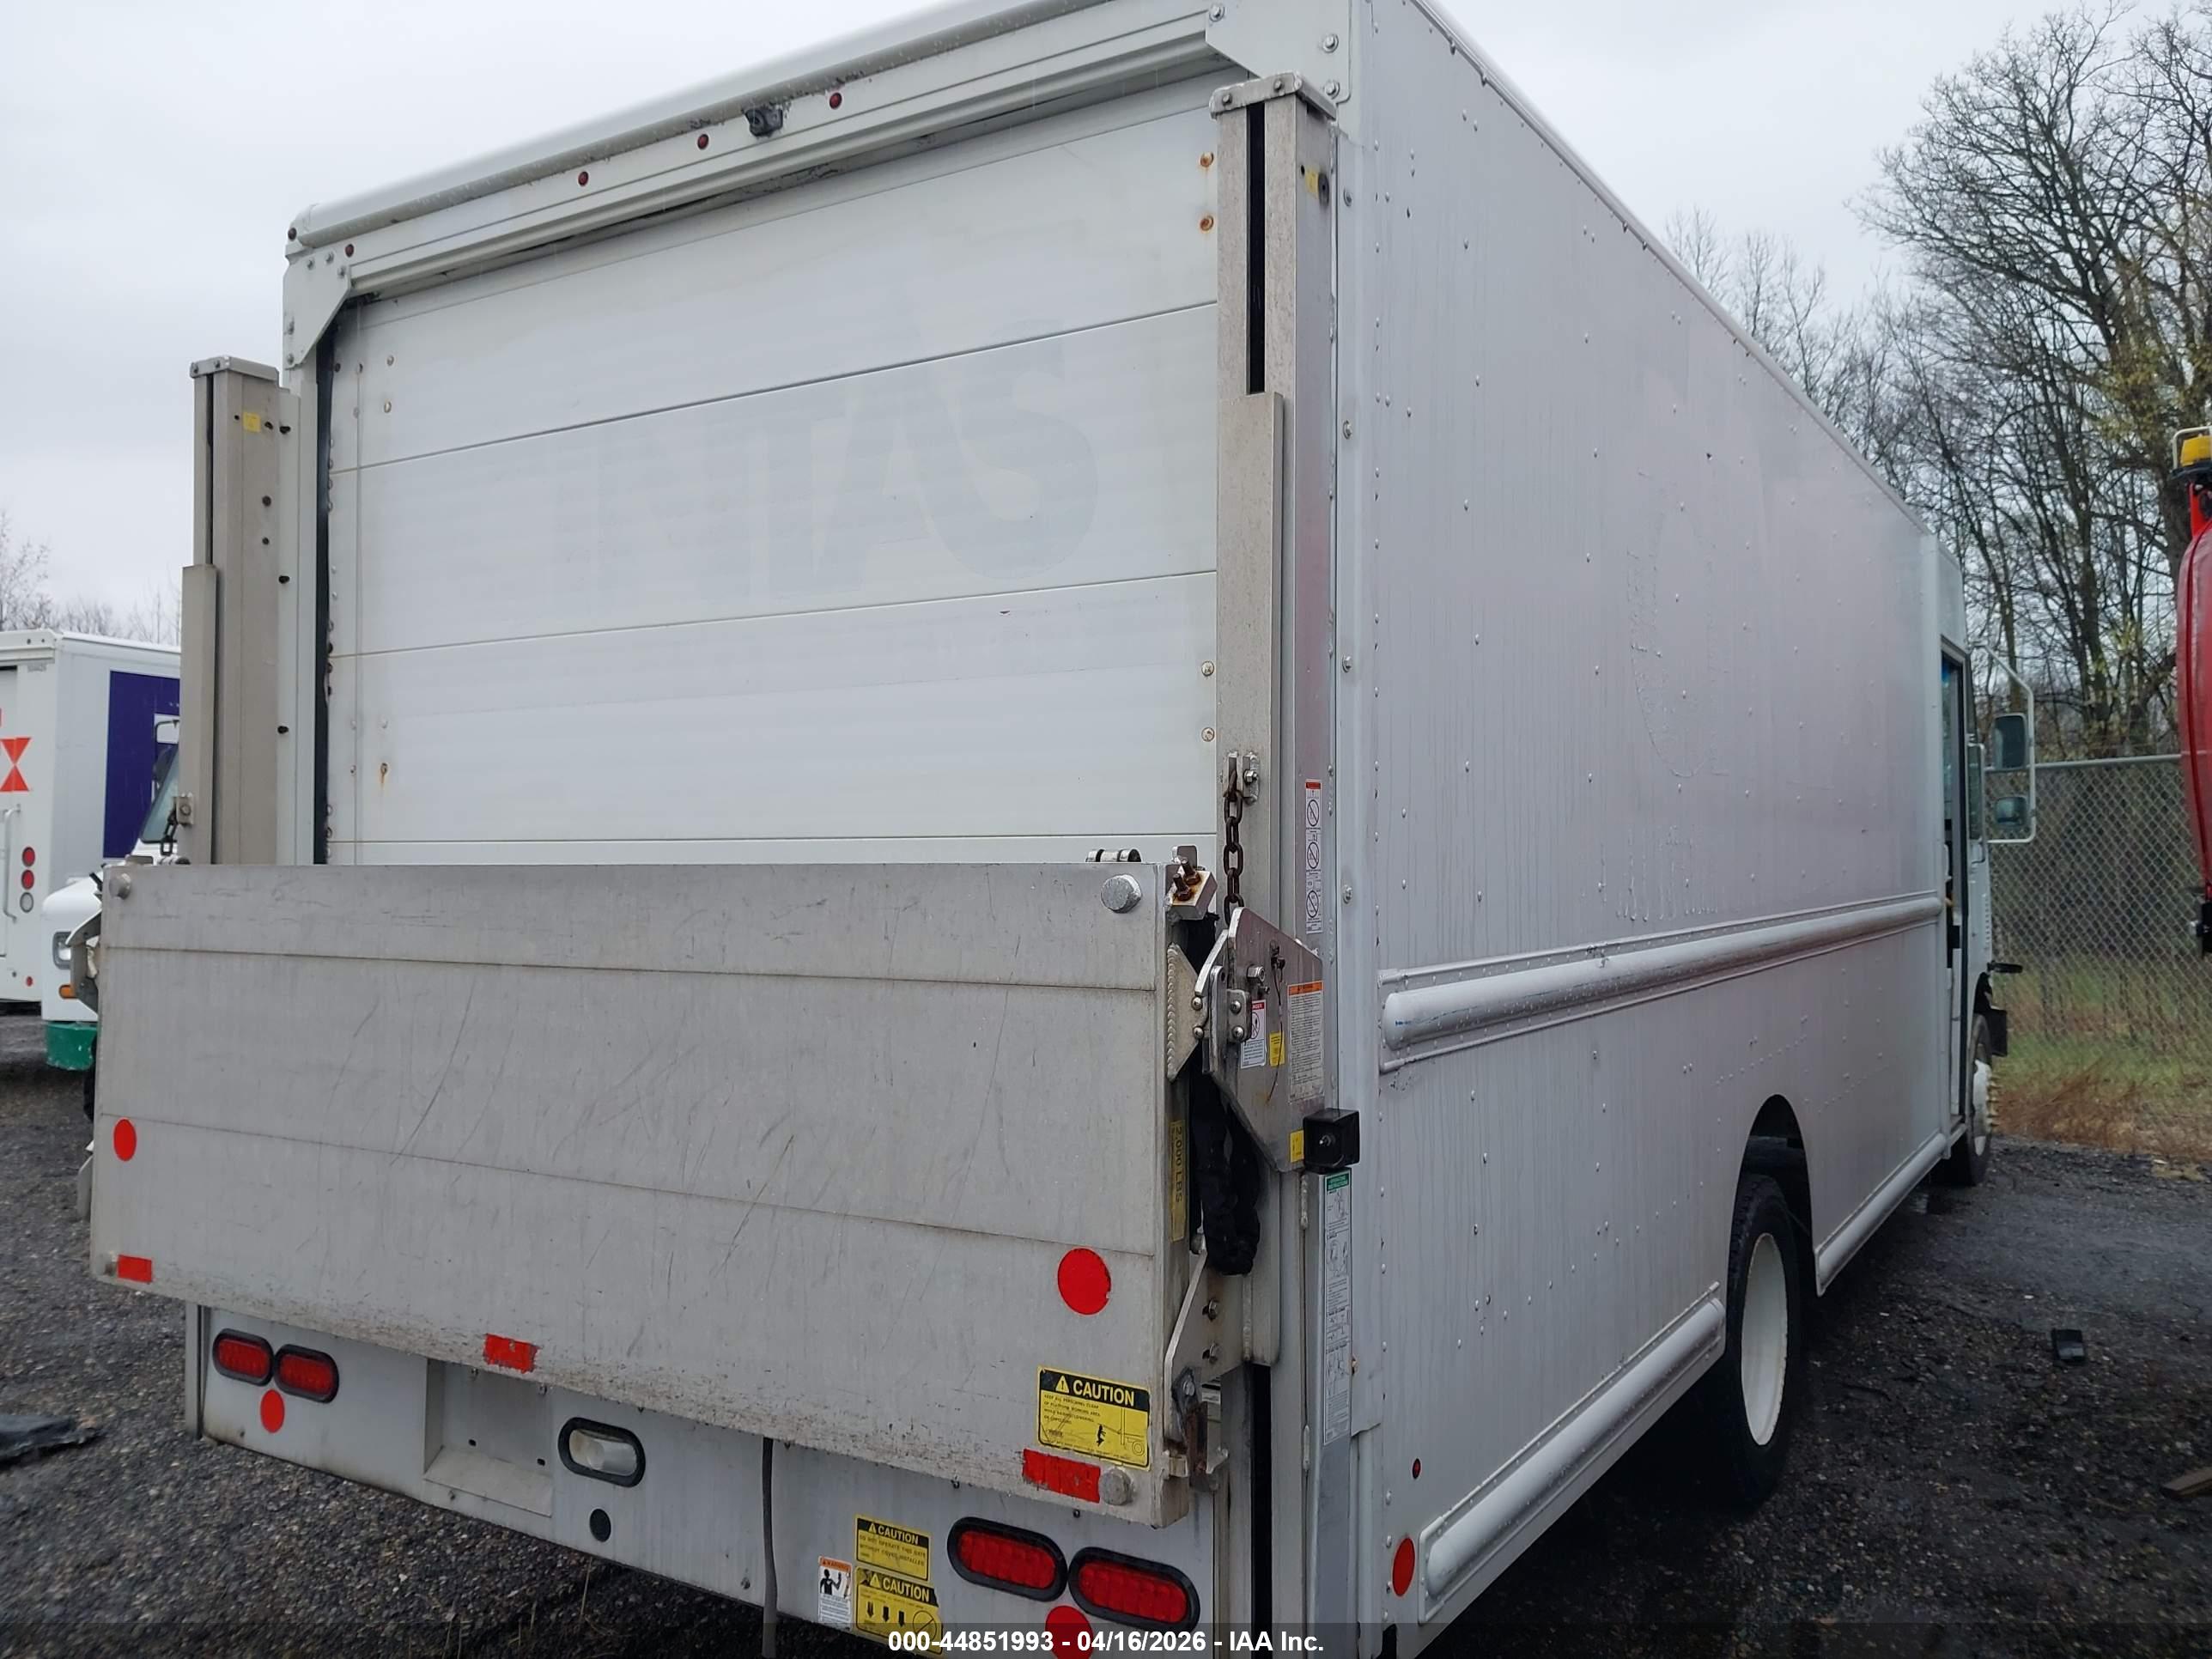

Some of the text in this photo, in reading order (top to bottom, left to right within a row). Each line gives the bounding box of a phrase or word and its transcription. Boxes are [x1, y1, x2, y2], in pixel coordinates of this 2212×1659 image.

[1175, 1171, 1183, 1204] LBS
[1073, 1379, 1135, 1407] CAUTION
[878, 1525, 919, 1546] CAUTION
[883, 1577, 930, 1602] CAUTION
